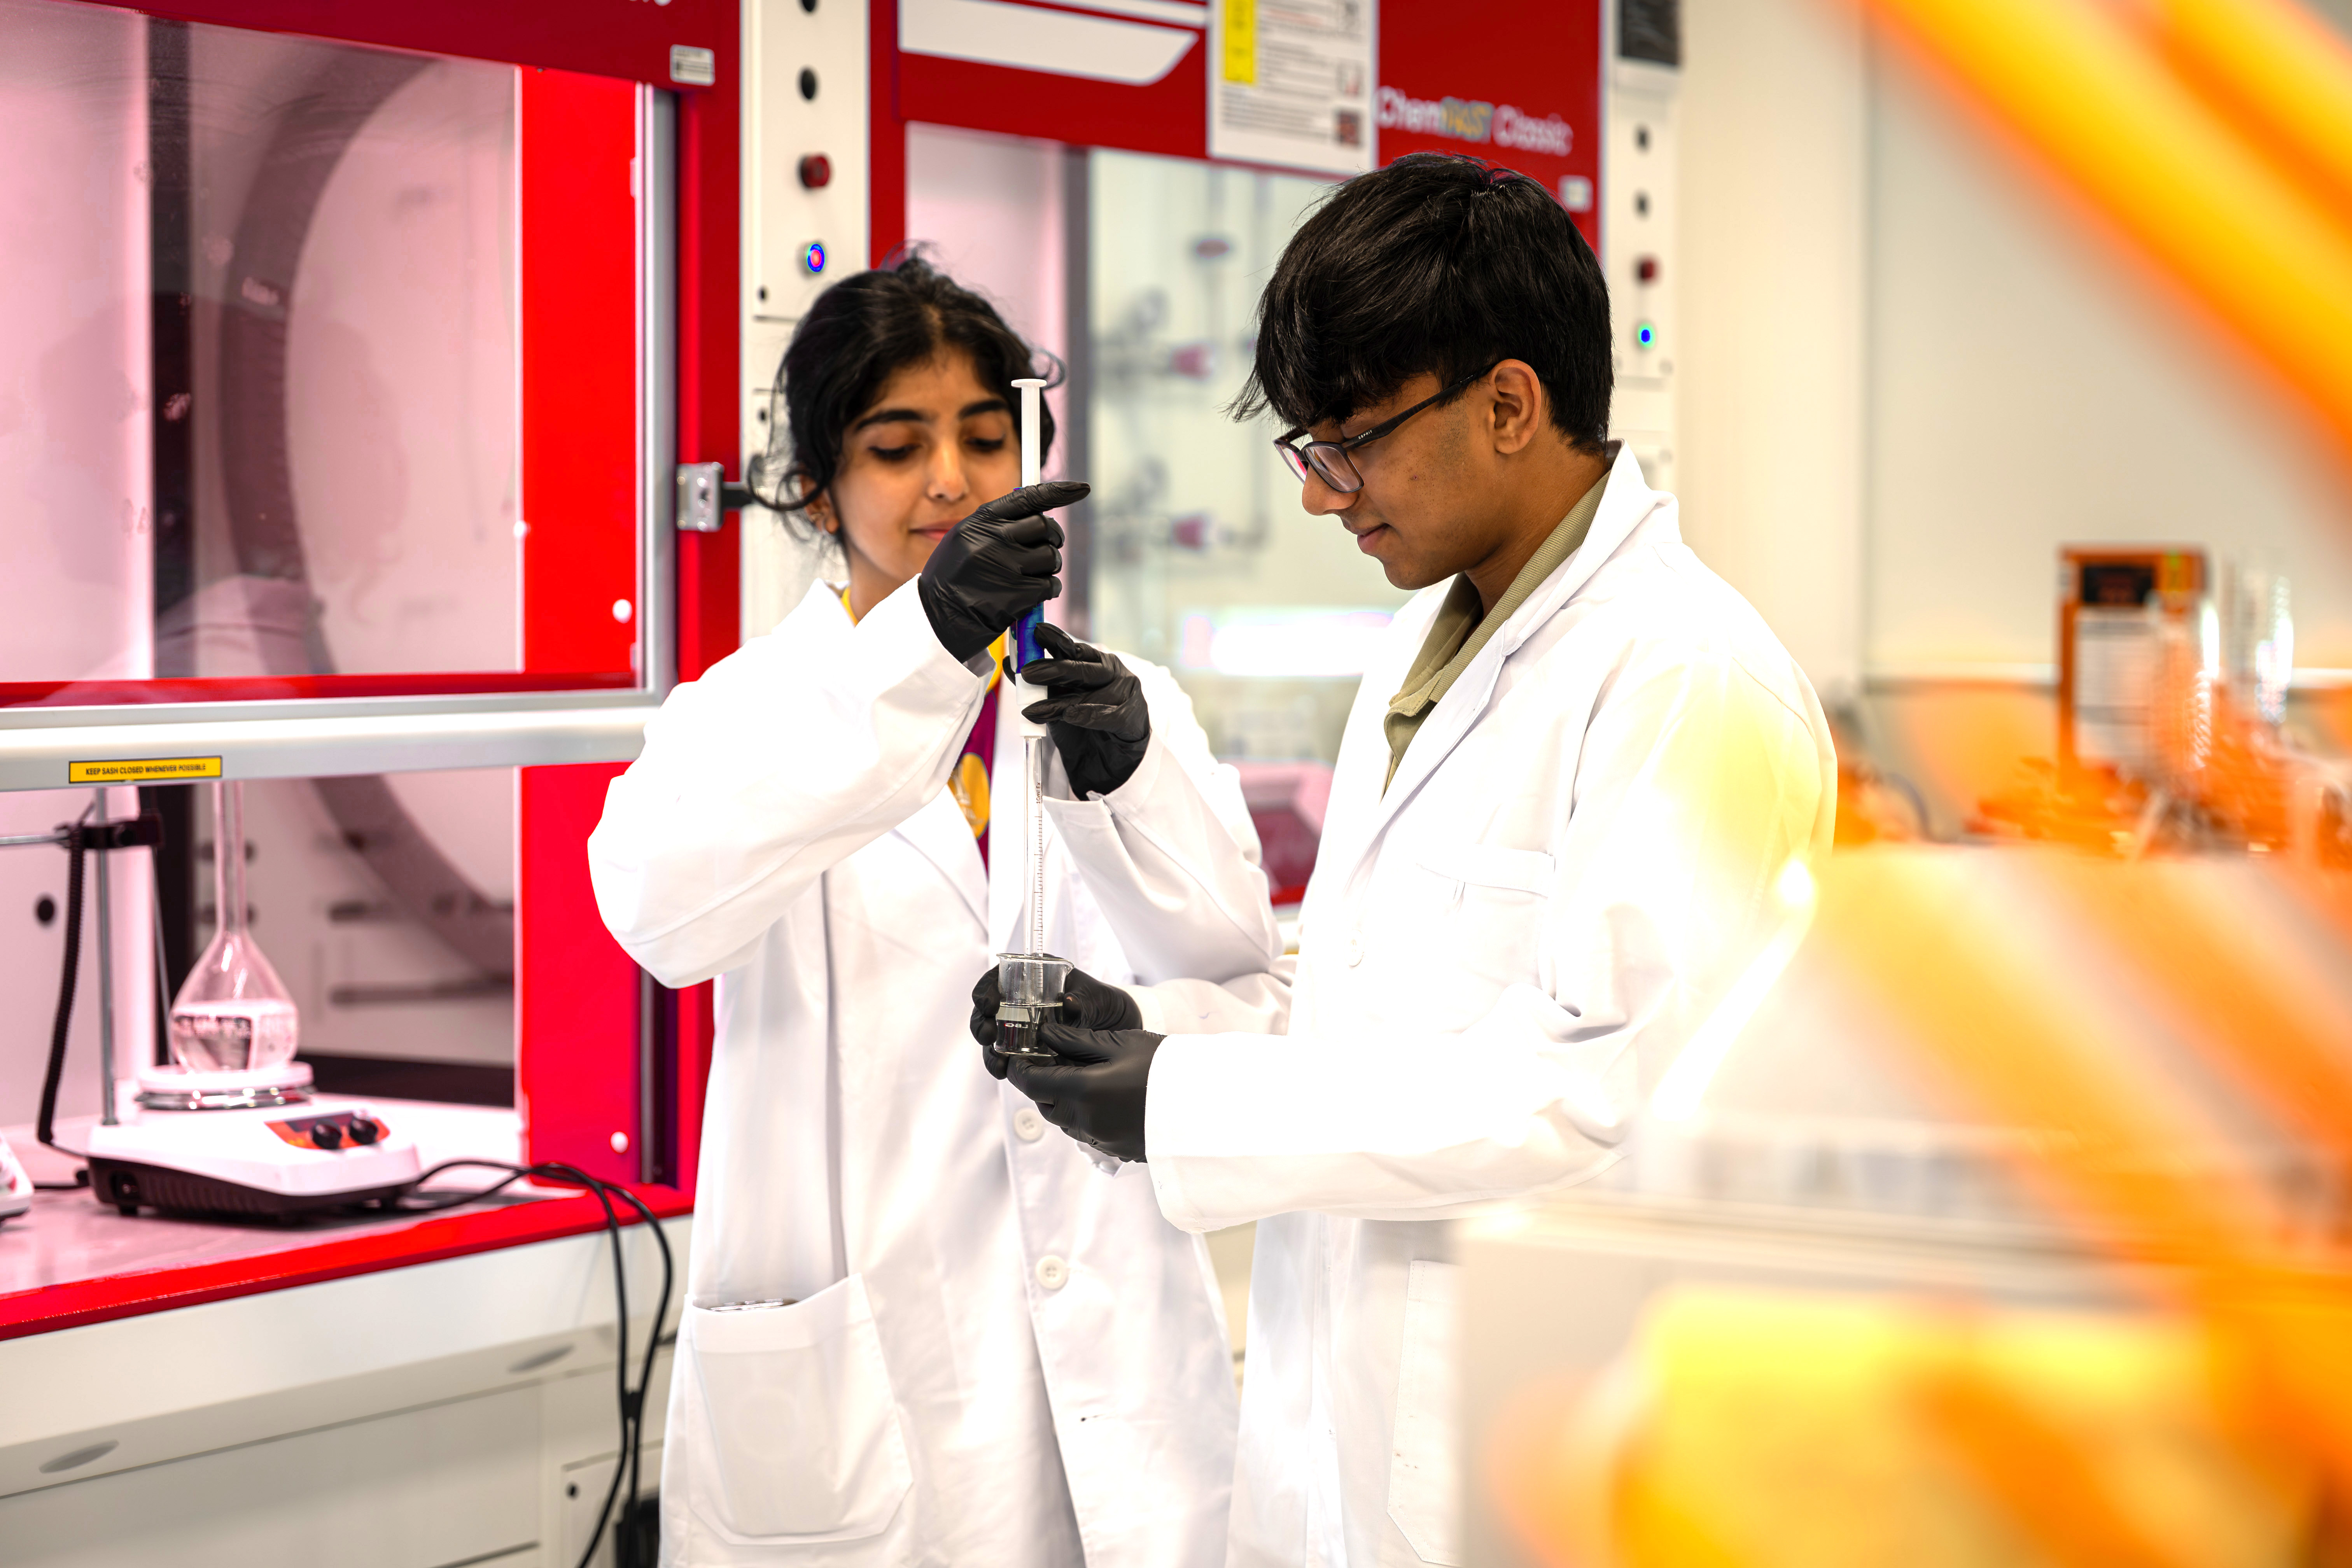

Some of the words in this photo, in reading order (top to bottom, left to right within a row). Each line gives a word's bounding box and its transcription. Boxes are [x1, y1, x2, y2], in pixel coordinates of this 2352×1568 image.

[1358, 430, 1372, 439] ESPRIT
[119, 766, 144, 774] CLOSED
[145, 765, 177, 774] WHENEVER
[178, 763, 206, 772] POSSIBLE
